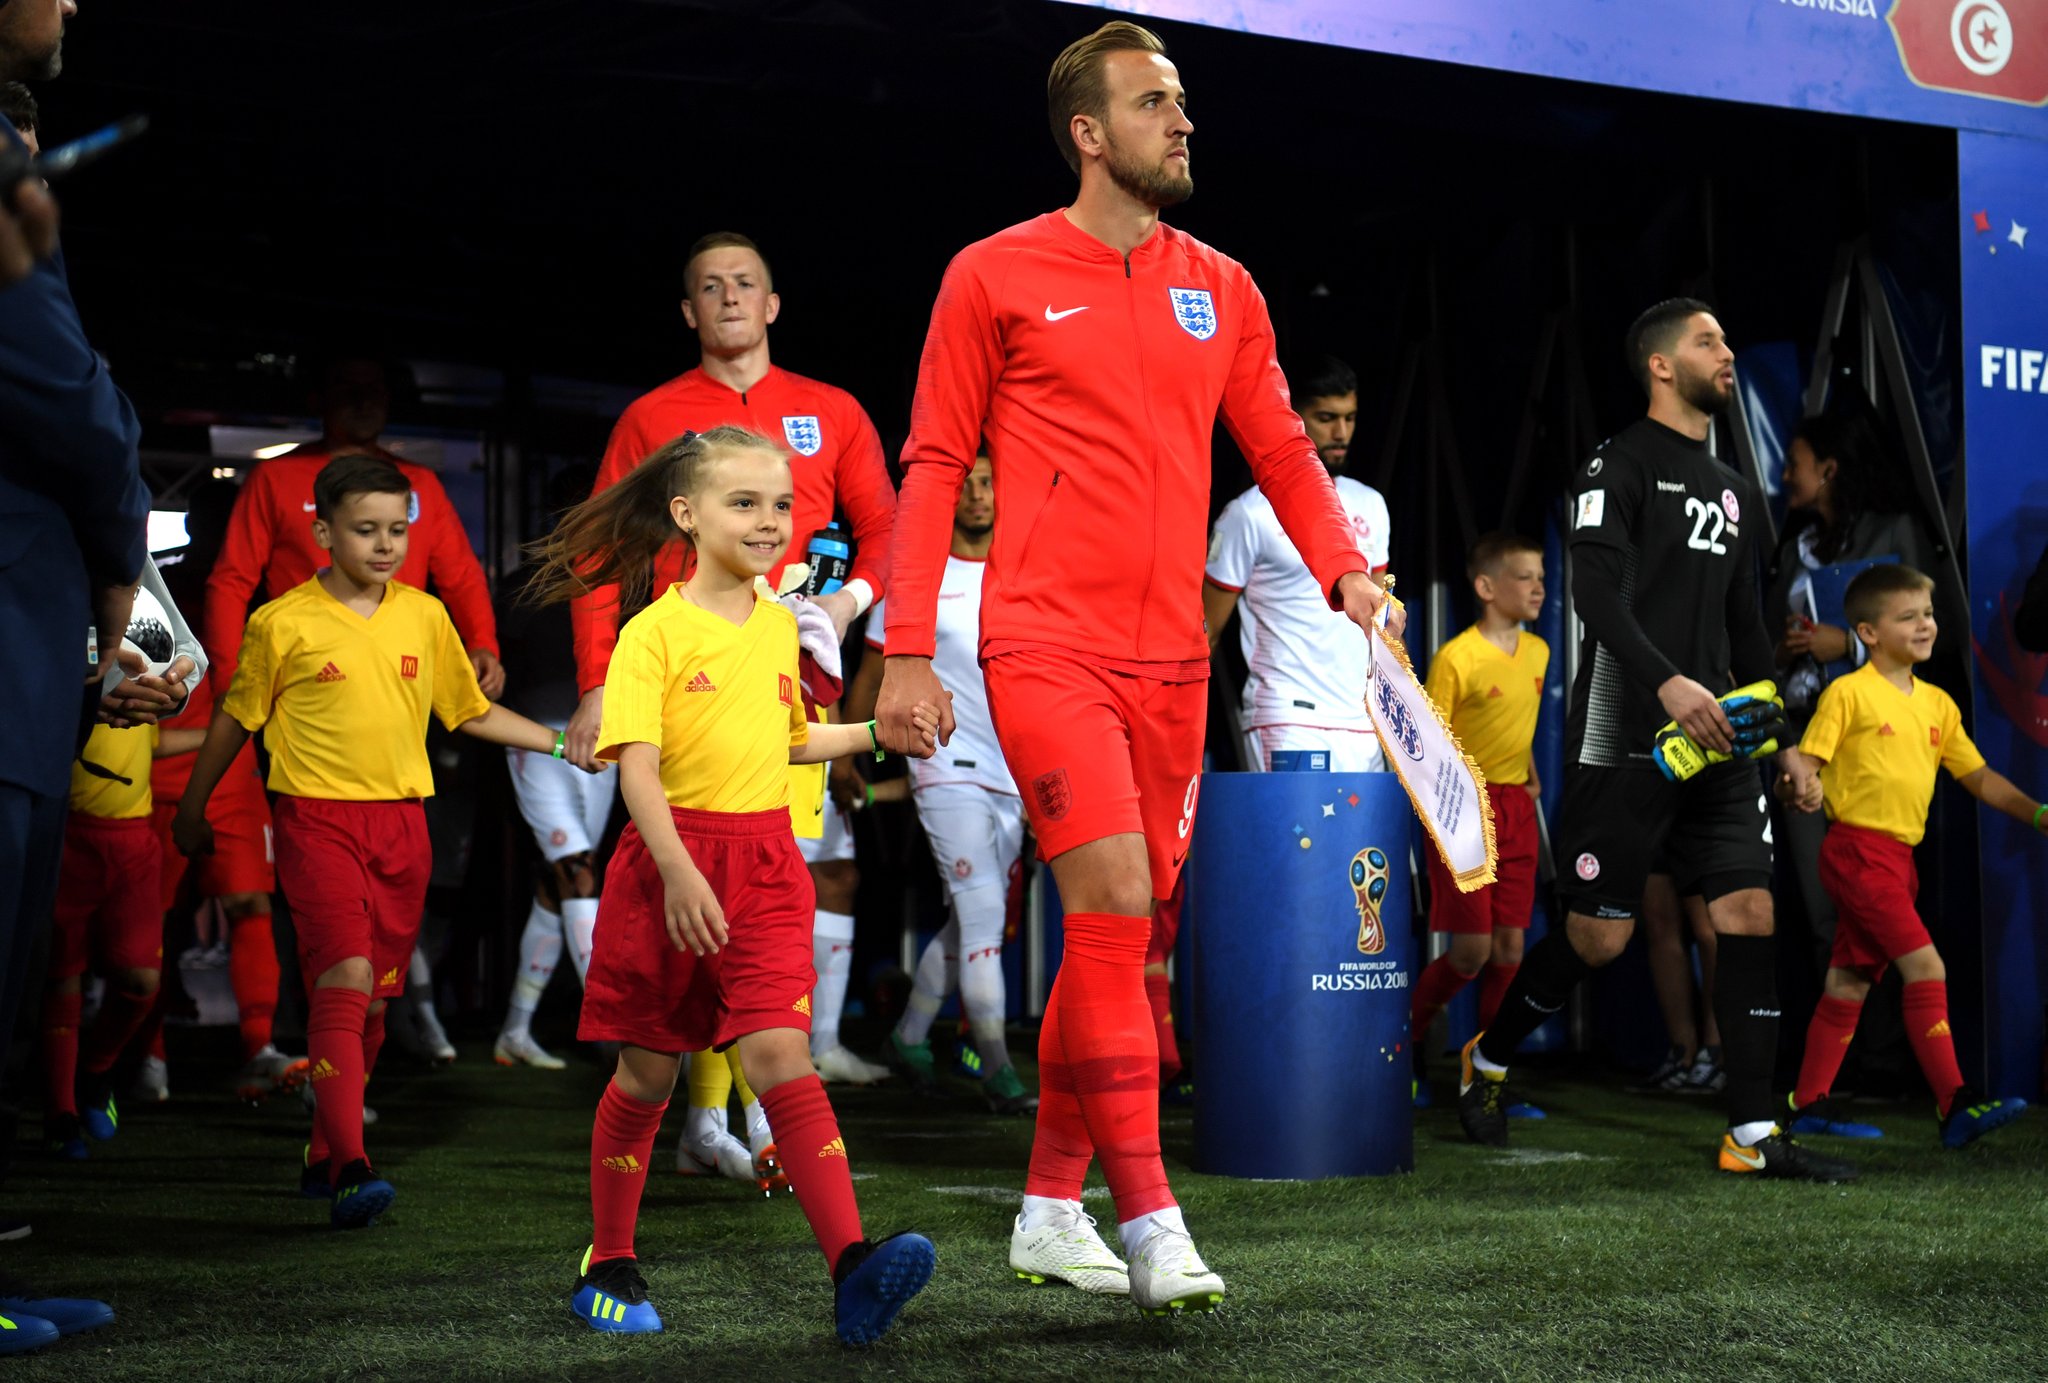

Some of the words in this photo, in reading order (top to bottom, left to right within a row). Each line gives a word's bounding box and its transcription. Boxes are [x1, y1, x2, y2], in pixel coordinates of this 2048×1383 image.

[1685, 497, 1727, 555] 22
[684, 684, 717, 692] adidas
[1669, 744, 1694, 772] MOUEZ
[1178, 774, 1198, 839] 9
[1339, 962, 1358, 971] FIFA
[1359, 962, 1384, 971] WORLD
[1385, 961, 1396, 970] CUP
[1312, 973, 1382, 991] RUSSIA
[1384, 971, 1408, 989] 2018
[818, 1148, 847, 1159] adid
[601, 1159, 643, 1173] adidas
